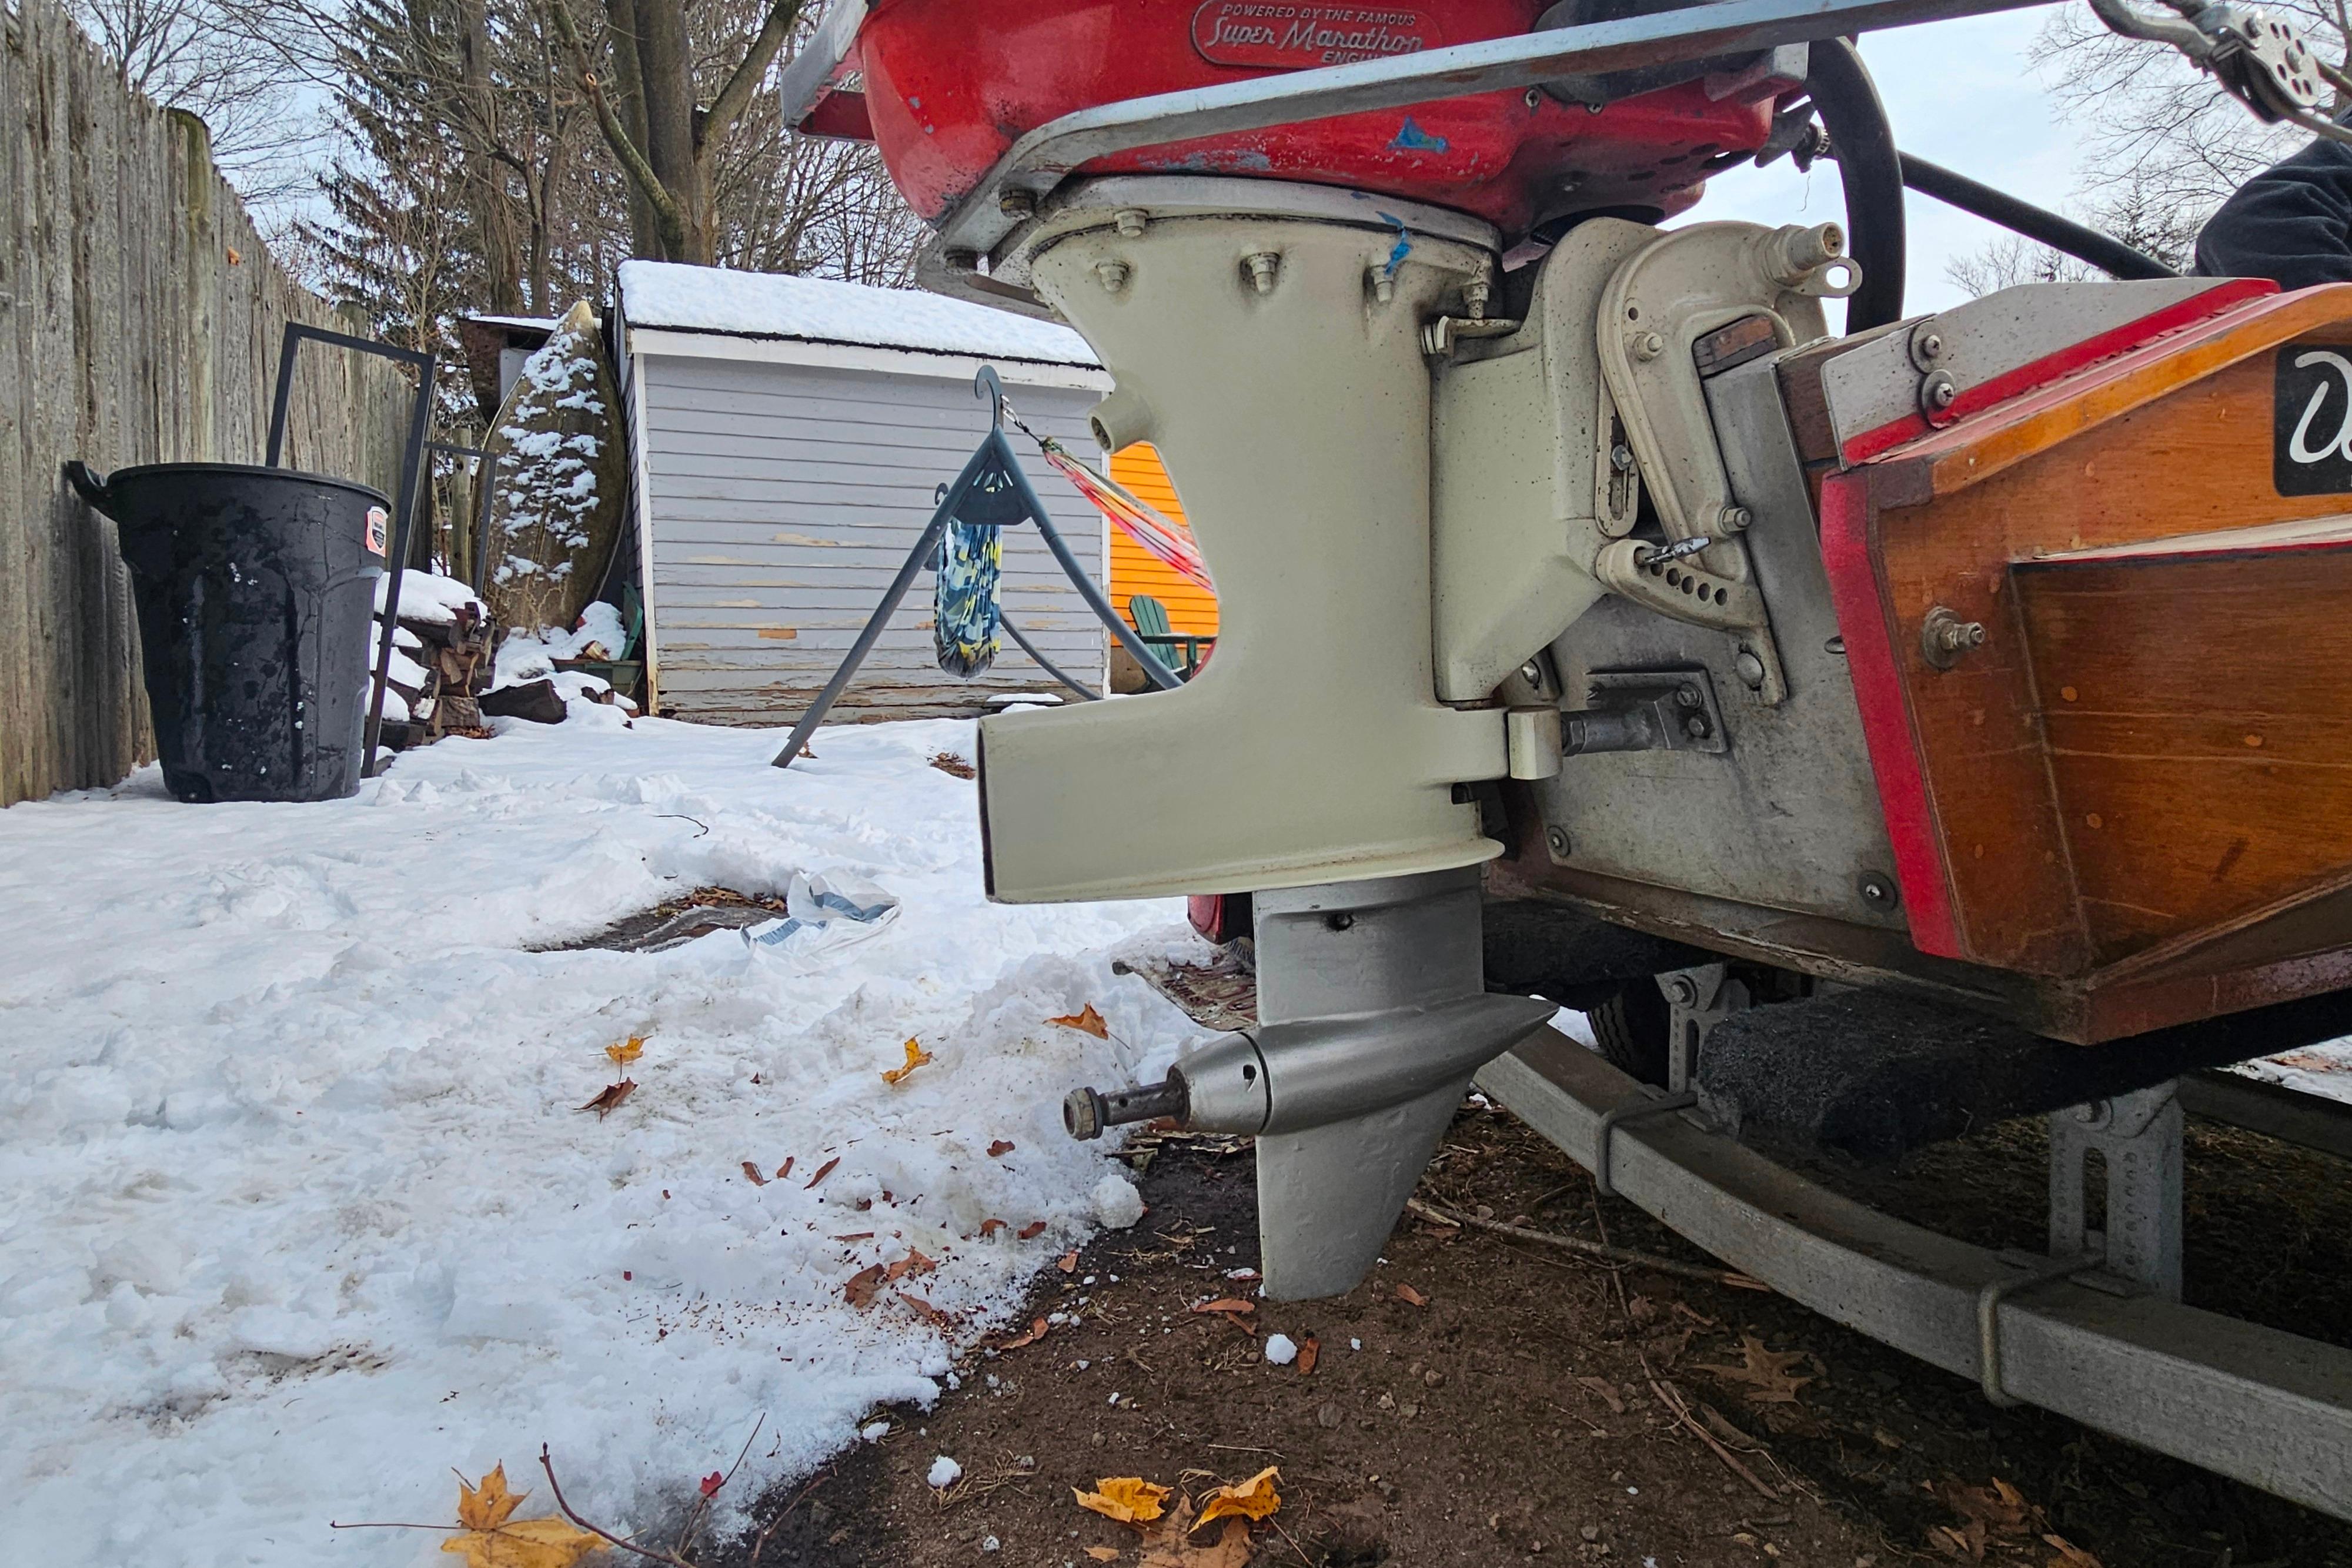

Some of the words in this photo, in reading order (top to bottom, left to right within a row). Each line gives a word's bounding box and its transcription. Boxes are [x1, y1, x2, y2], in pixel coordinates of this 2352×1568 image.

[1221, 4, 1295, 18] POWERED
[1299, 8, 1321, 19] BY
[1325, 9, 1353, 21] THE
[1356, 12, 1416, 26] FAMOUS
[1205, 16, 1275, 47] Super
[1277, 20, 1423, 53] Marathon
